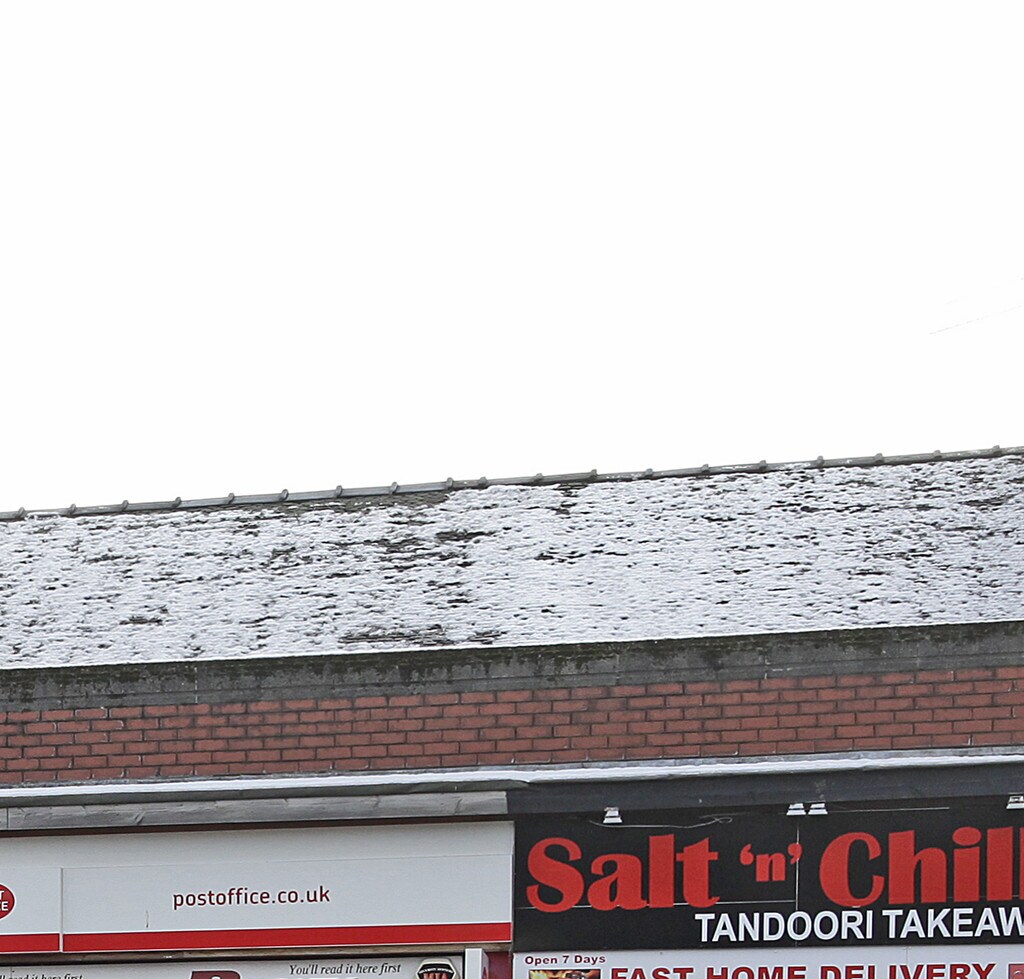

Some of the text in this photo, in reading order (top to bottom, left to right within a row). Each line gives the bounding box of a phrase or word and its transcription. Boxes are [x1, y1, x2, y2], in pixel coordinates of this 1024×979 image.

[526, 834, 720, 912] Salt
[819, 826, 1024, 907] Chil
[173, 886, 331, 910] postoffice.co.uk
[695, 910, 873, 942] TANDOORI
[289, 962, 402, 976] You'll read it here first
[525, 954, 606, 967] Open 7 Days
